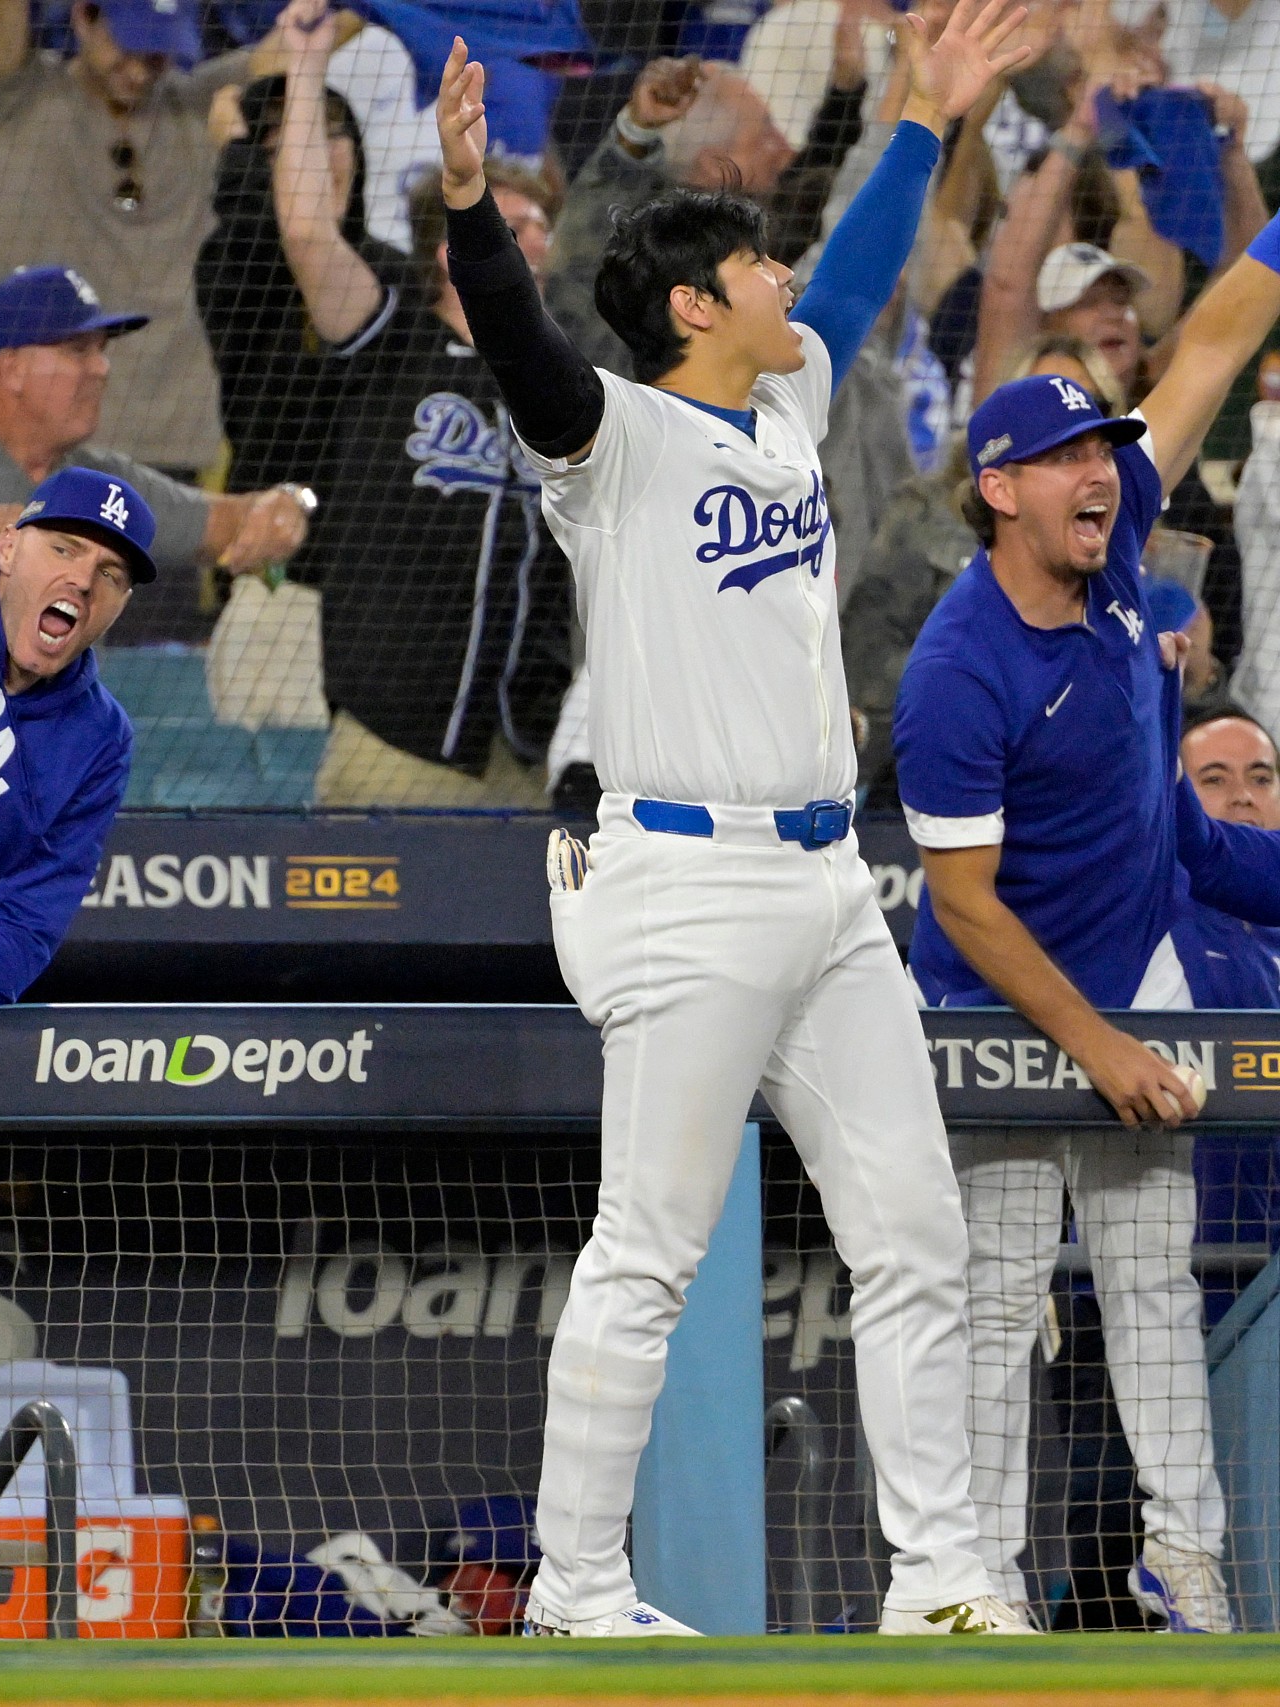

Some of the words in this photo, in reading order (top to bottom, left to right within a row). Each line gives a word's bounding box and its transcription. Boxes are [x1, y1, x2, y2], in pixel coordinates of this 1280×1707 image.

[1049, 377, 1091, 411] LA
[99, 483, 130, 531] LA
[284, 867, 401, 897] 2024
[34, 1027, 374, 1097] loanDepot
